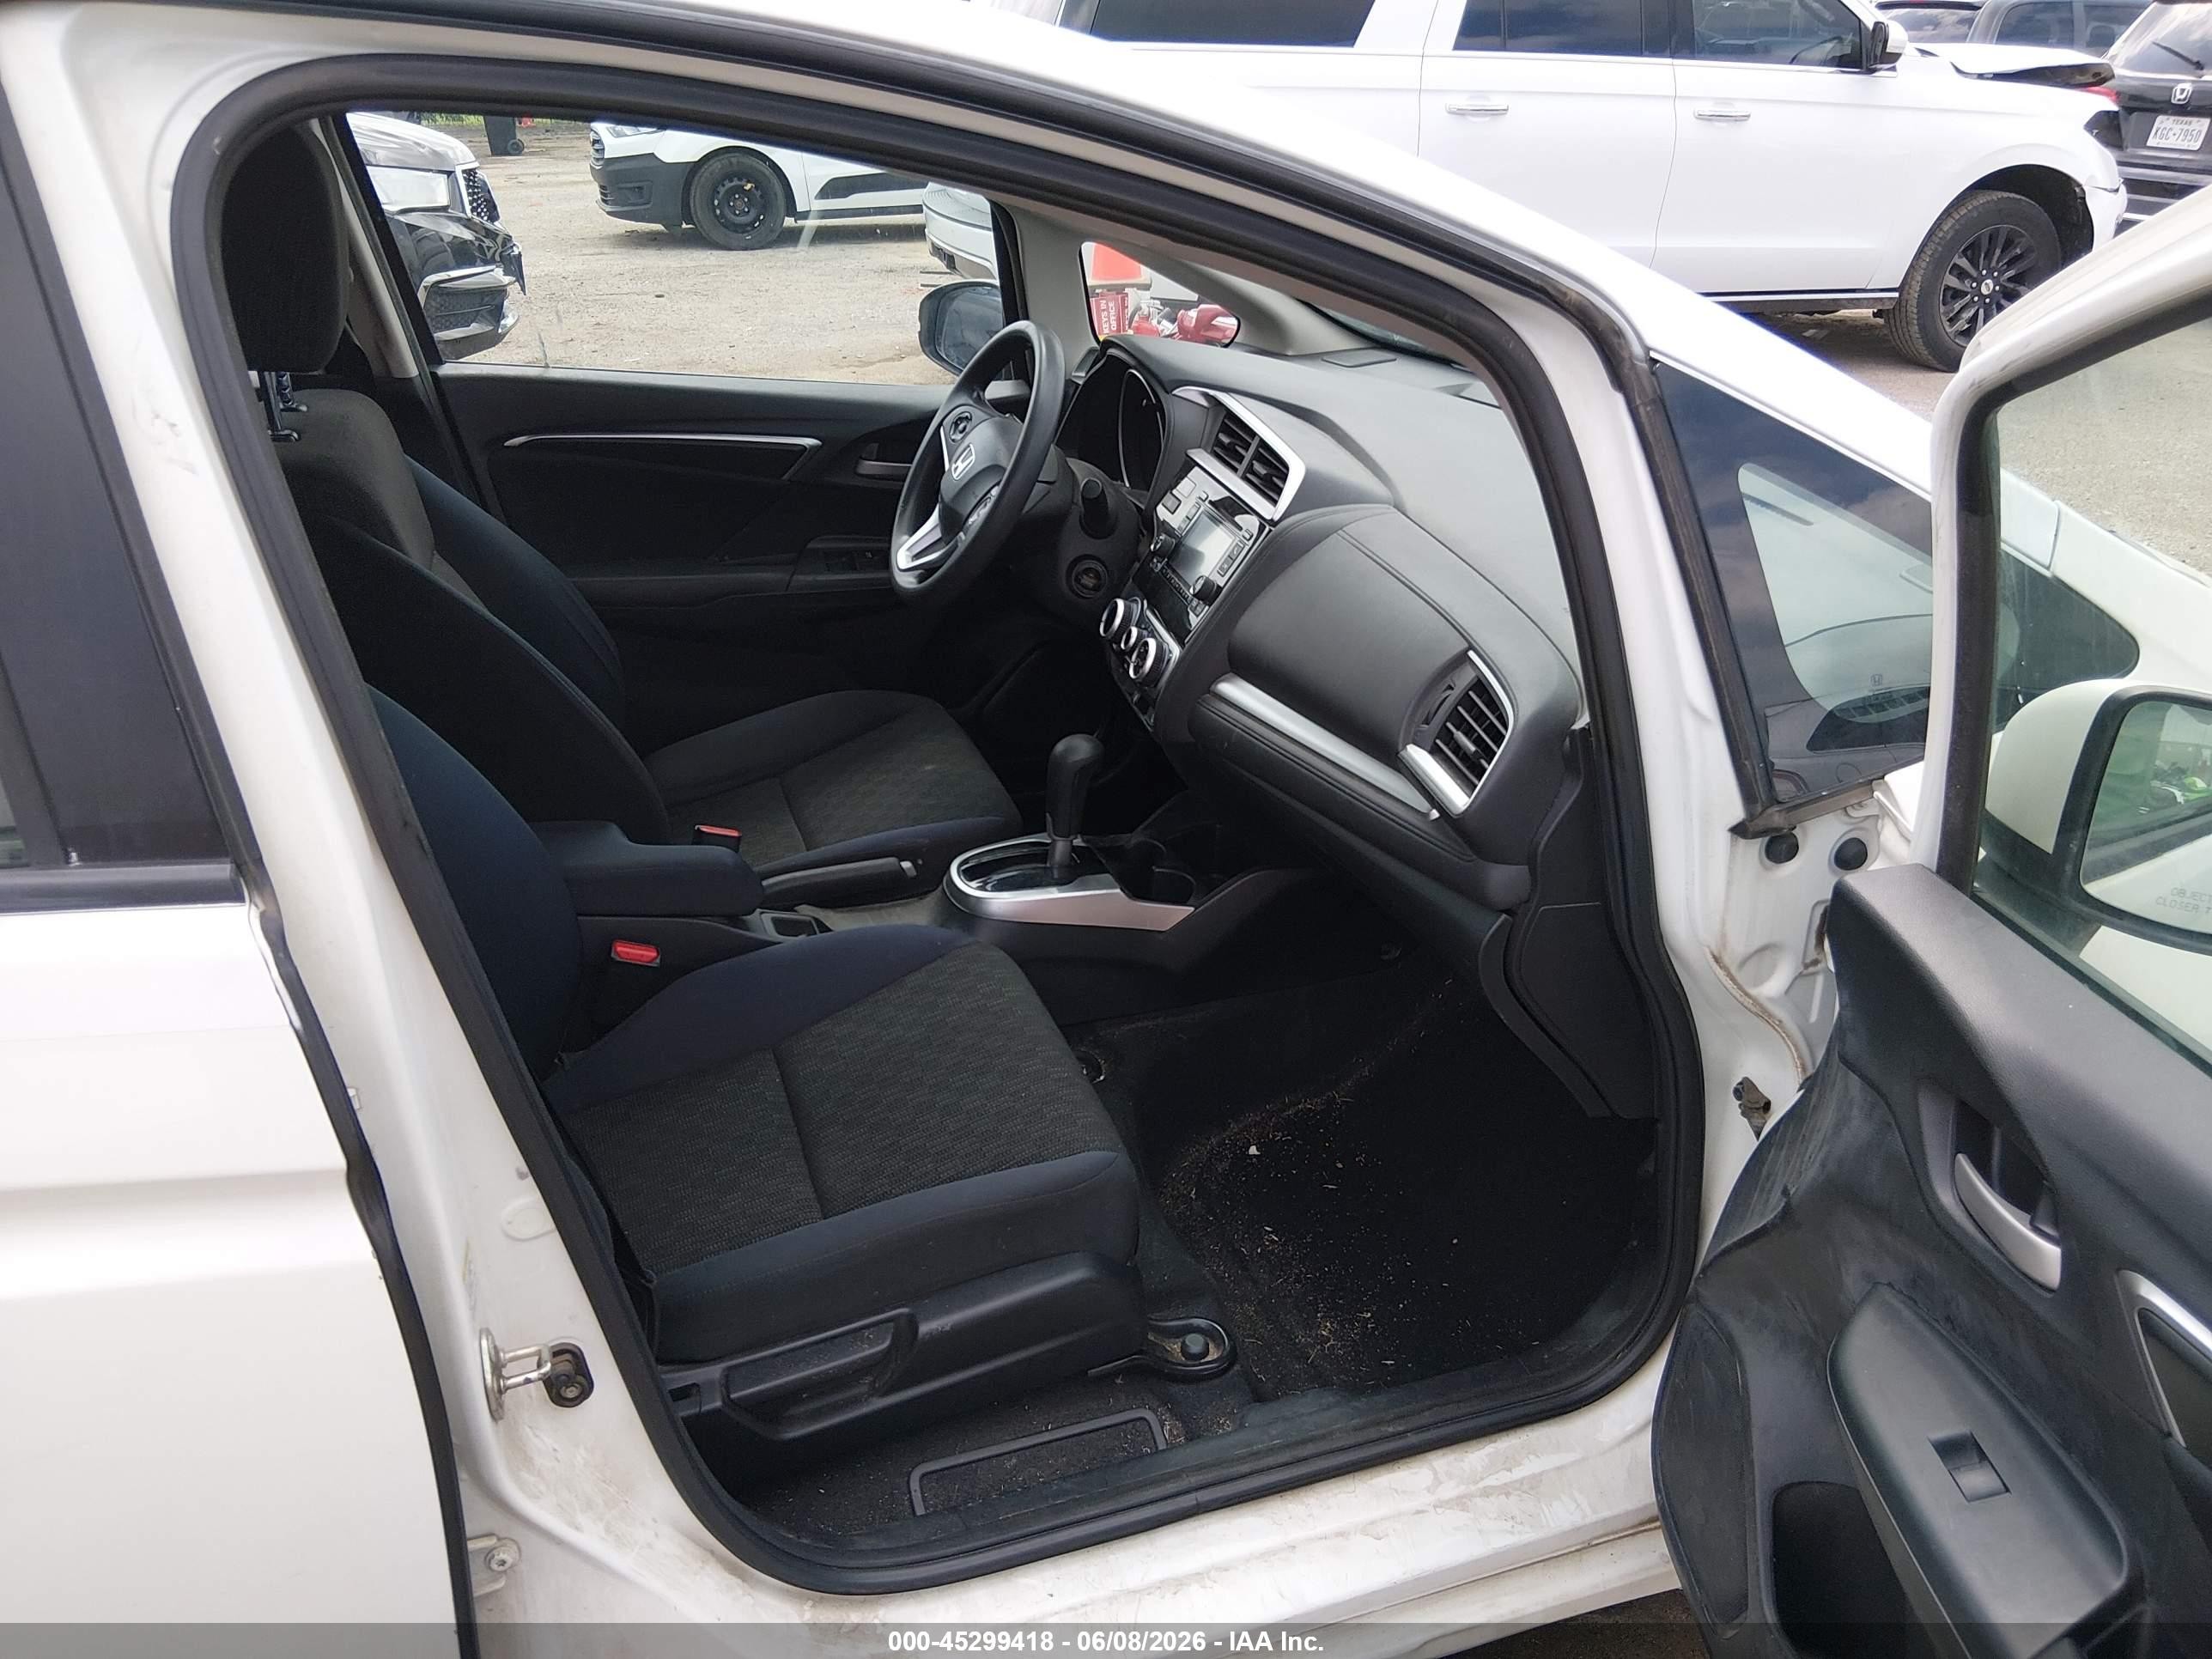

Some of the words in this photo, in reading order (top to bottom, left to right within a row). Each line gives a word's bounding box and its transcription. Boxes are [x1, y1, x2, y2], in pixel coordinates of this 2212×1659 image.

[1099, 300, 1107, 310] IN
[1101, 311, 1109, 334] KEYS
[1108, 301, 1117, 331] OFFICE
[2155, 896, 2200, 915] CLOSER
